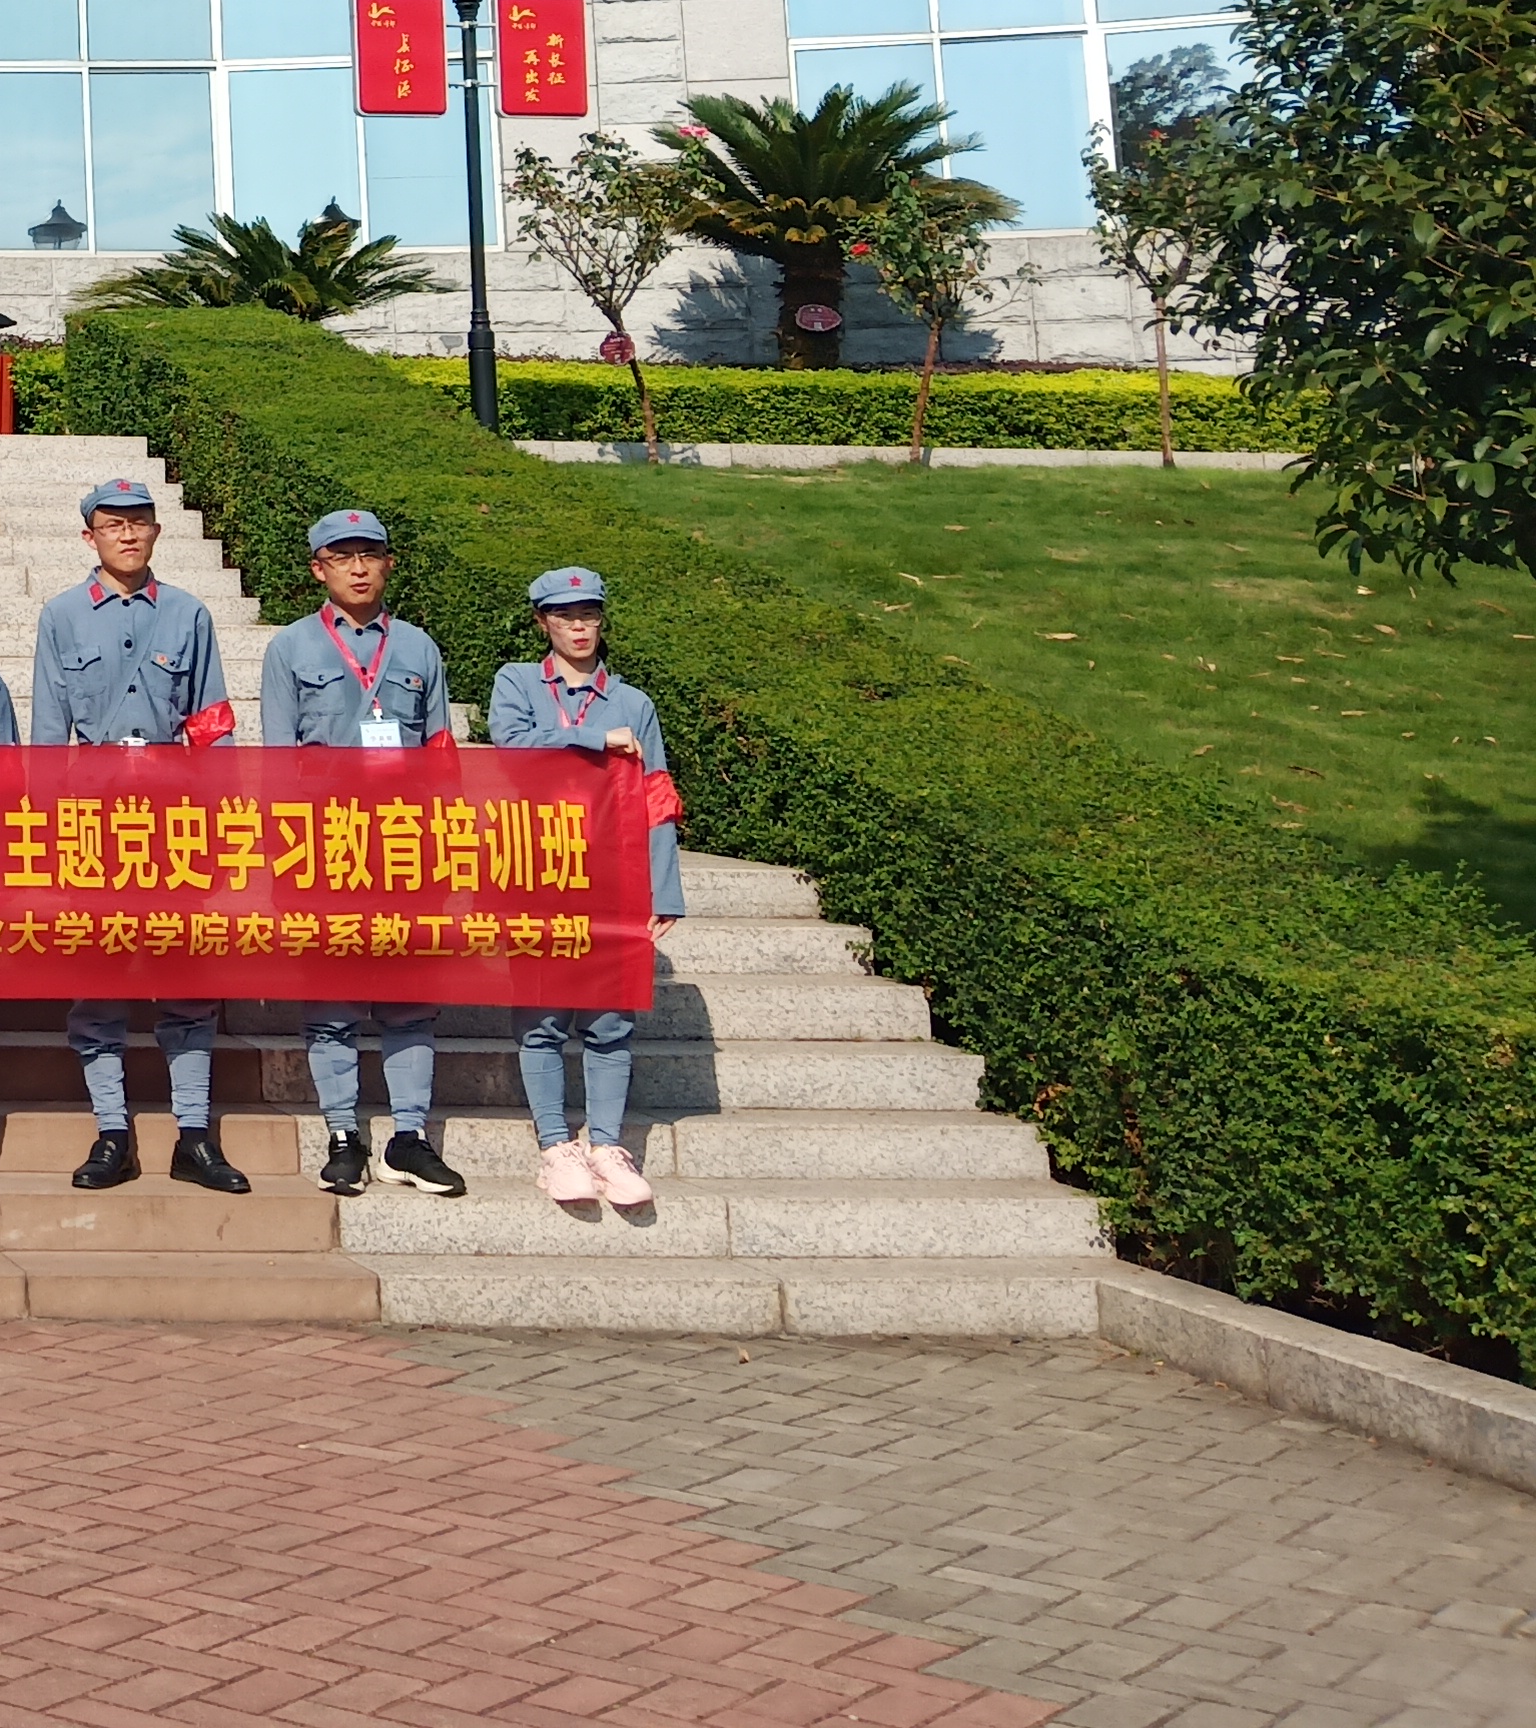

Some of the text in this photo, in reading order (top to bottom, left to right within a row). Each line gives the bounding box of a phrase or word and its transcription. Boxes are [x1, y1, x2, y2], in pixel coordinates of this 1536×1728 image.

[522, 49, 541, 103] 再出发
[545, 32, 566, 86] 新长征
